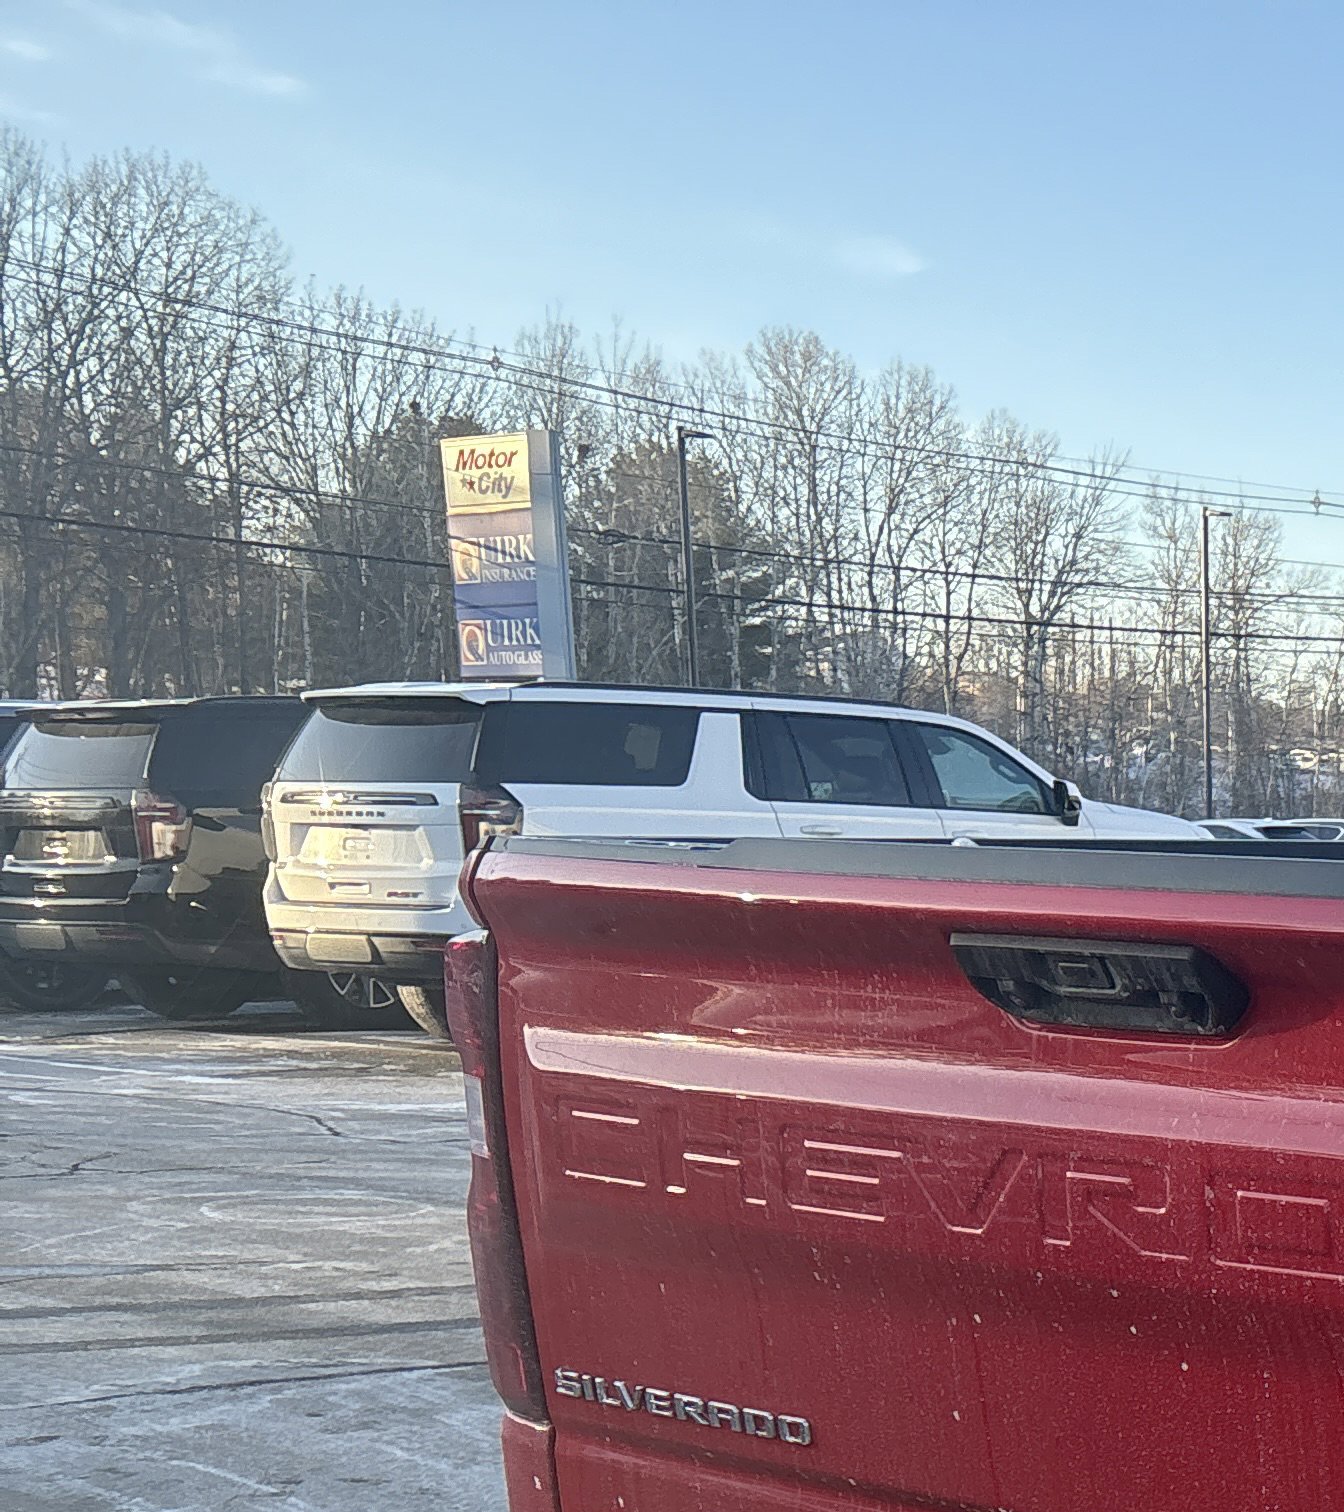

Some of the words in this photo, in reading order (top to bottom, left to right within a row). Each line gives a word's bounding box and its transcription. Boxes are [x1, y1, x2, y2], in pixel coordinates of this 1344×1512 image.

[455, 447, 518, 472] Motor
[477, 471, 516, 499] City
[453, 534, 536, 583] QUIRK
[482, 566, 536, 583] INSURANCE
[463, 617, 541, 663] QUIRK
[554, 1366, 812, 1446] SILVERADO
